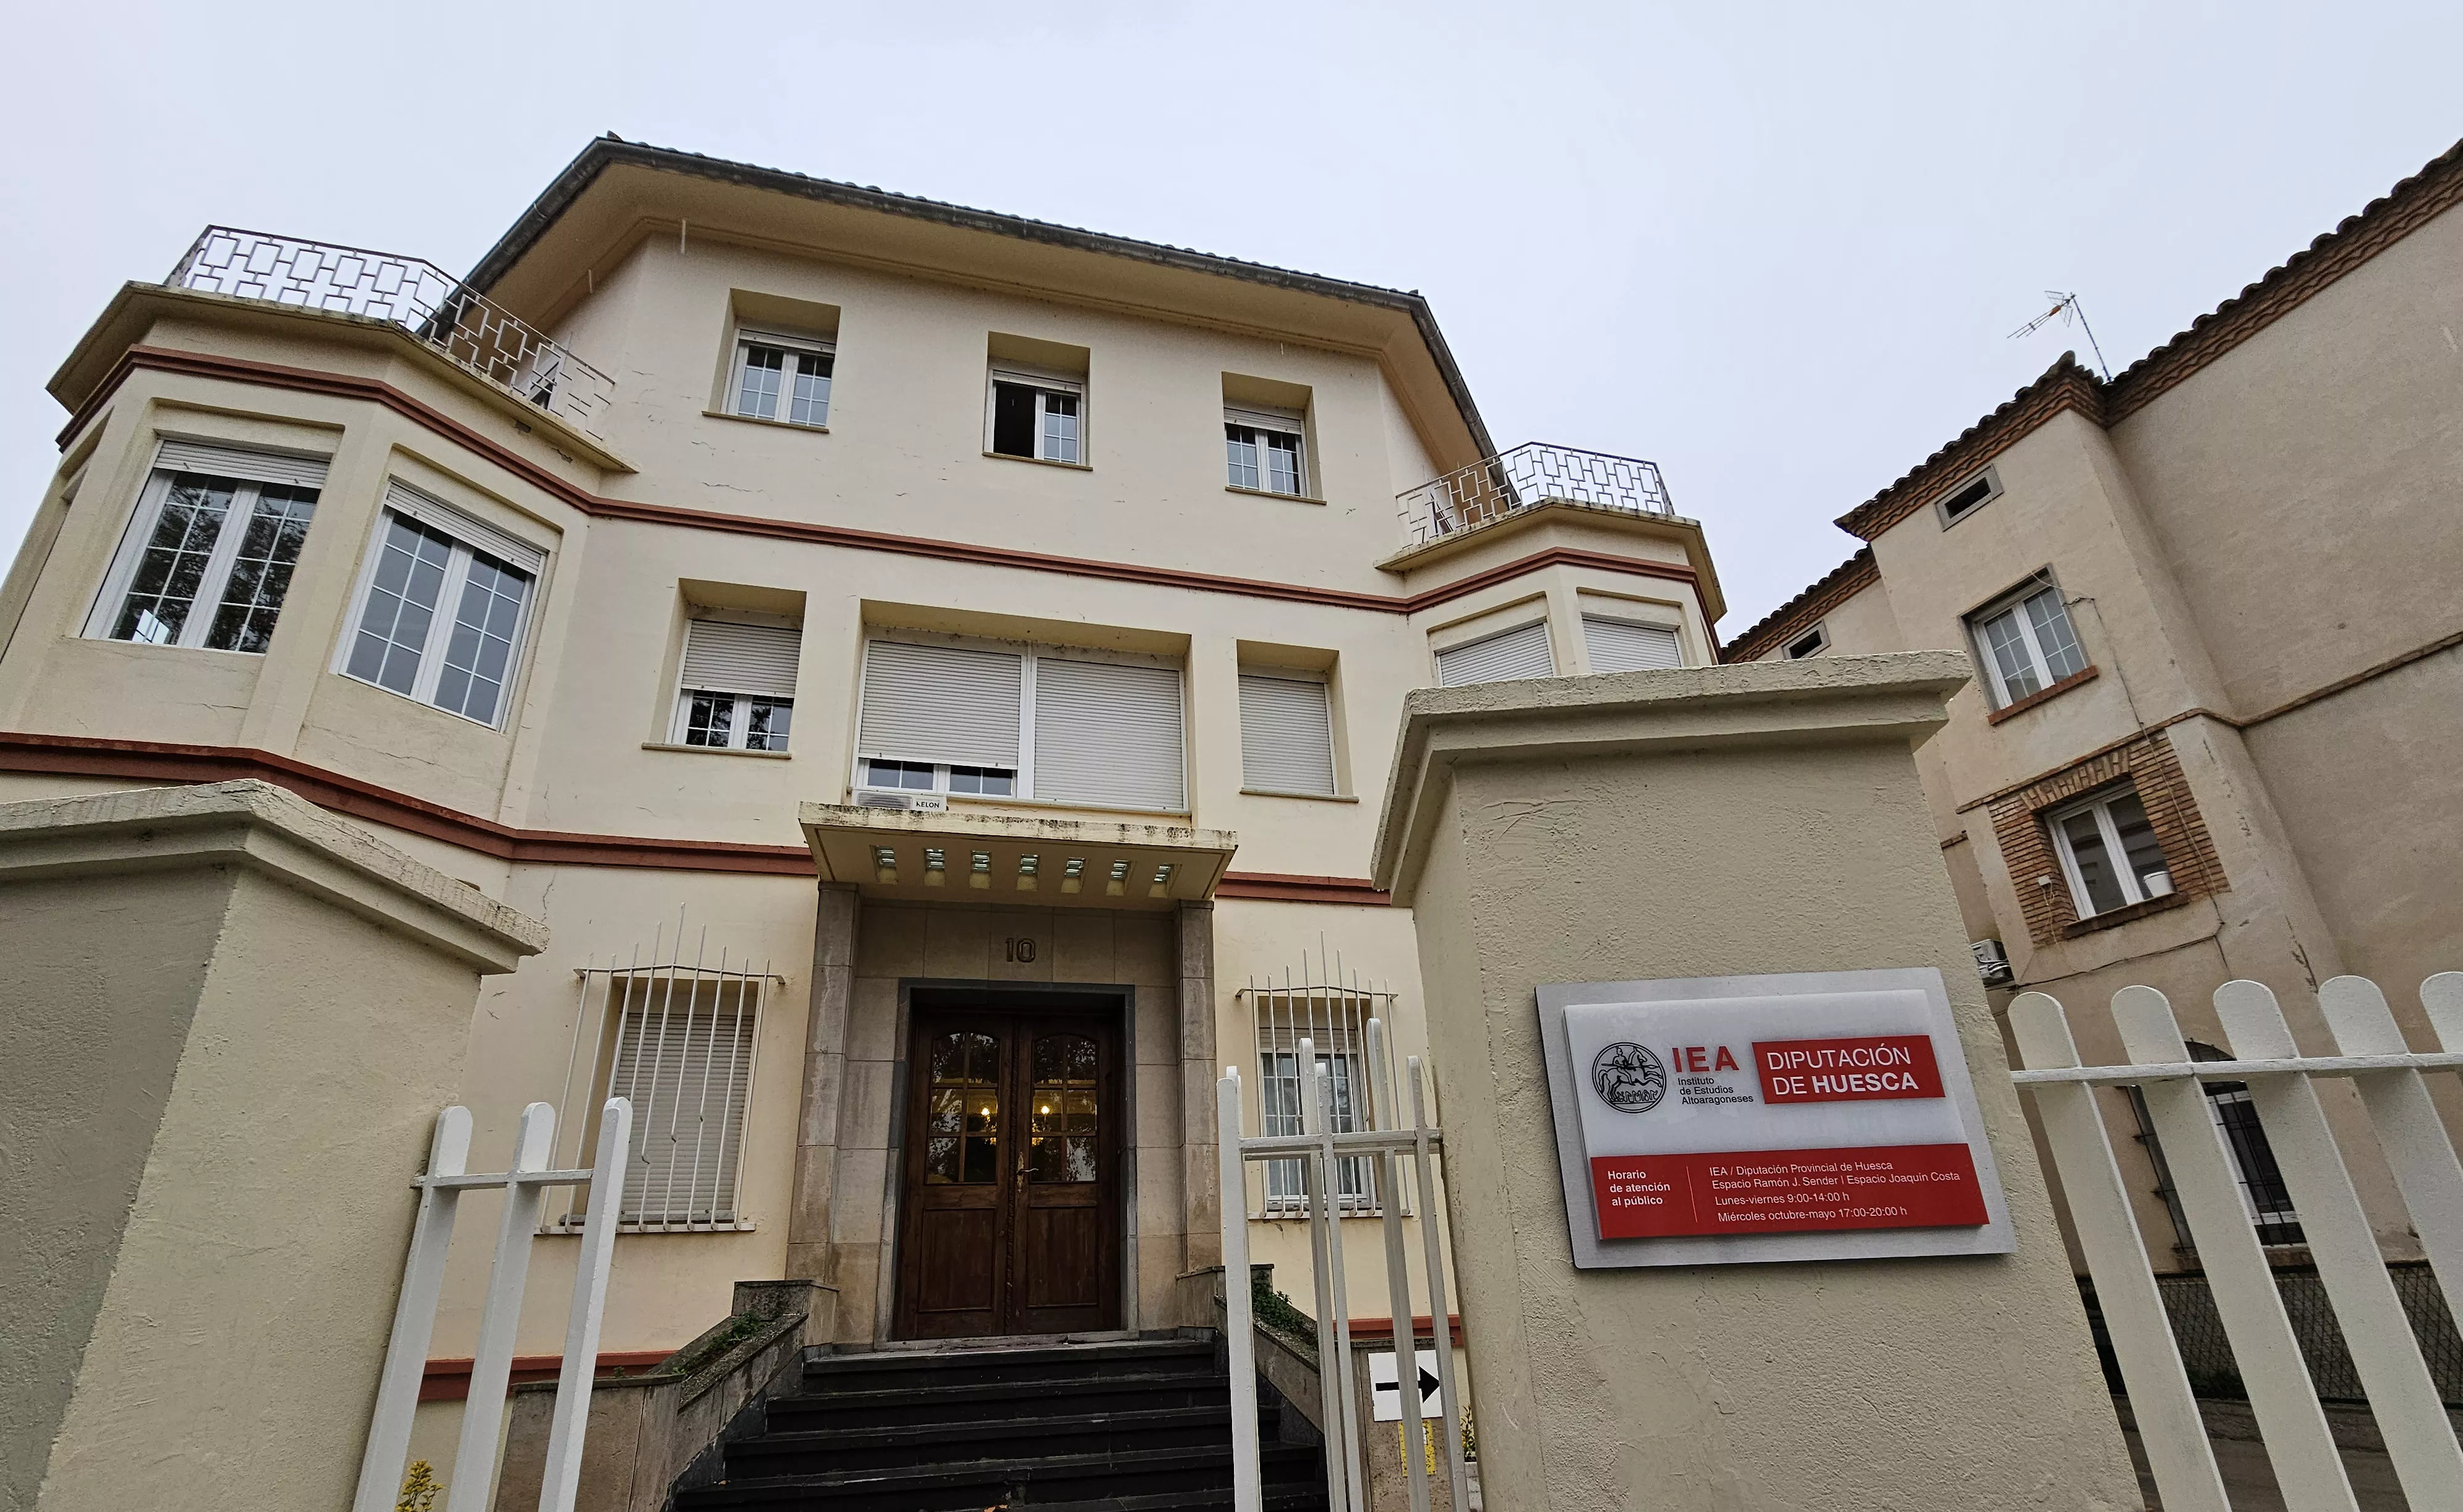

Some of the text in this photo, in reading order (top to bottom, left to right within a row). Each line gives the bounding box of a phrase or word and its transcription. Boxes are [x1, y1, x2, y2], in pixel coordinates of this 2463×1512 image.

[1005, 937, 1036, 963] 10
[1672, 1046, 1739, 1073] IEA
[1767, 1043, 1911, 1070] DIPUTACIÓN
[1678, 1077, 1714, 1085] Instituto
[1772, 1072, 1919, 1095] DE HUESCA
[1680, 1085, 1734, 1095] de Estudios
[1682, 1095, 1754, 1105] Altoaragoneses
[1608, 1170, 1647, 1180] Horario
[1709, 1167, 1728, 1176] IEA
[1736, 1164, 1788, 1176] Diputación
[1791, 1162, 1838, 1173] Provincial
[1840, 1162, 1853, 1171] de
[1855, 1162, 1893, 1171] Huesca
[1610, 1181, 1671, 1192] de atención
[1712, 1179, 1751, 1191] Espacio
[1754, 1177, 1789, 1188] Ramón
[1792, 1177, 1800, 1186] J.
[1802, 1176, 1838, 1186] Sender
[1847, 1174, 1886, 1186] Espacio
[1930, 1172, 1961, 1181] Costa
[1612, 1196, 1663, 1208] al público
[1715, 1191, 1850, 1205] Lunes-viernes 9:00-14:00 h
[1718, 1206, 1908, 1222] Miércoles octubre-mayo 17:00-20:00 h
